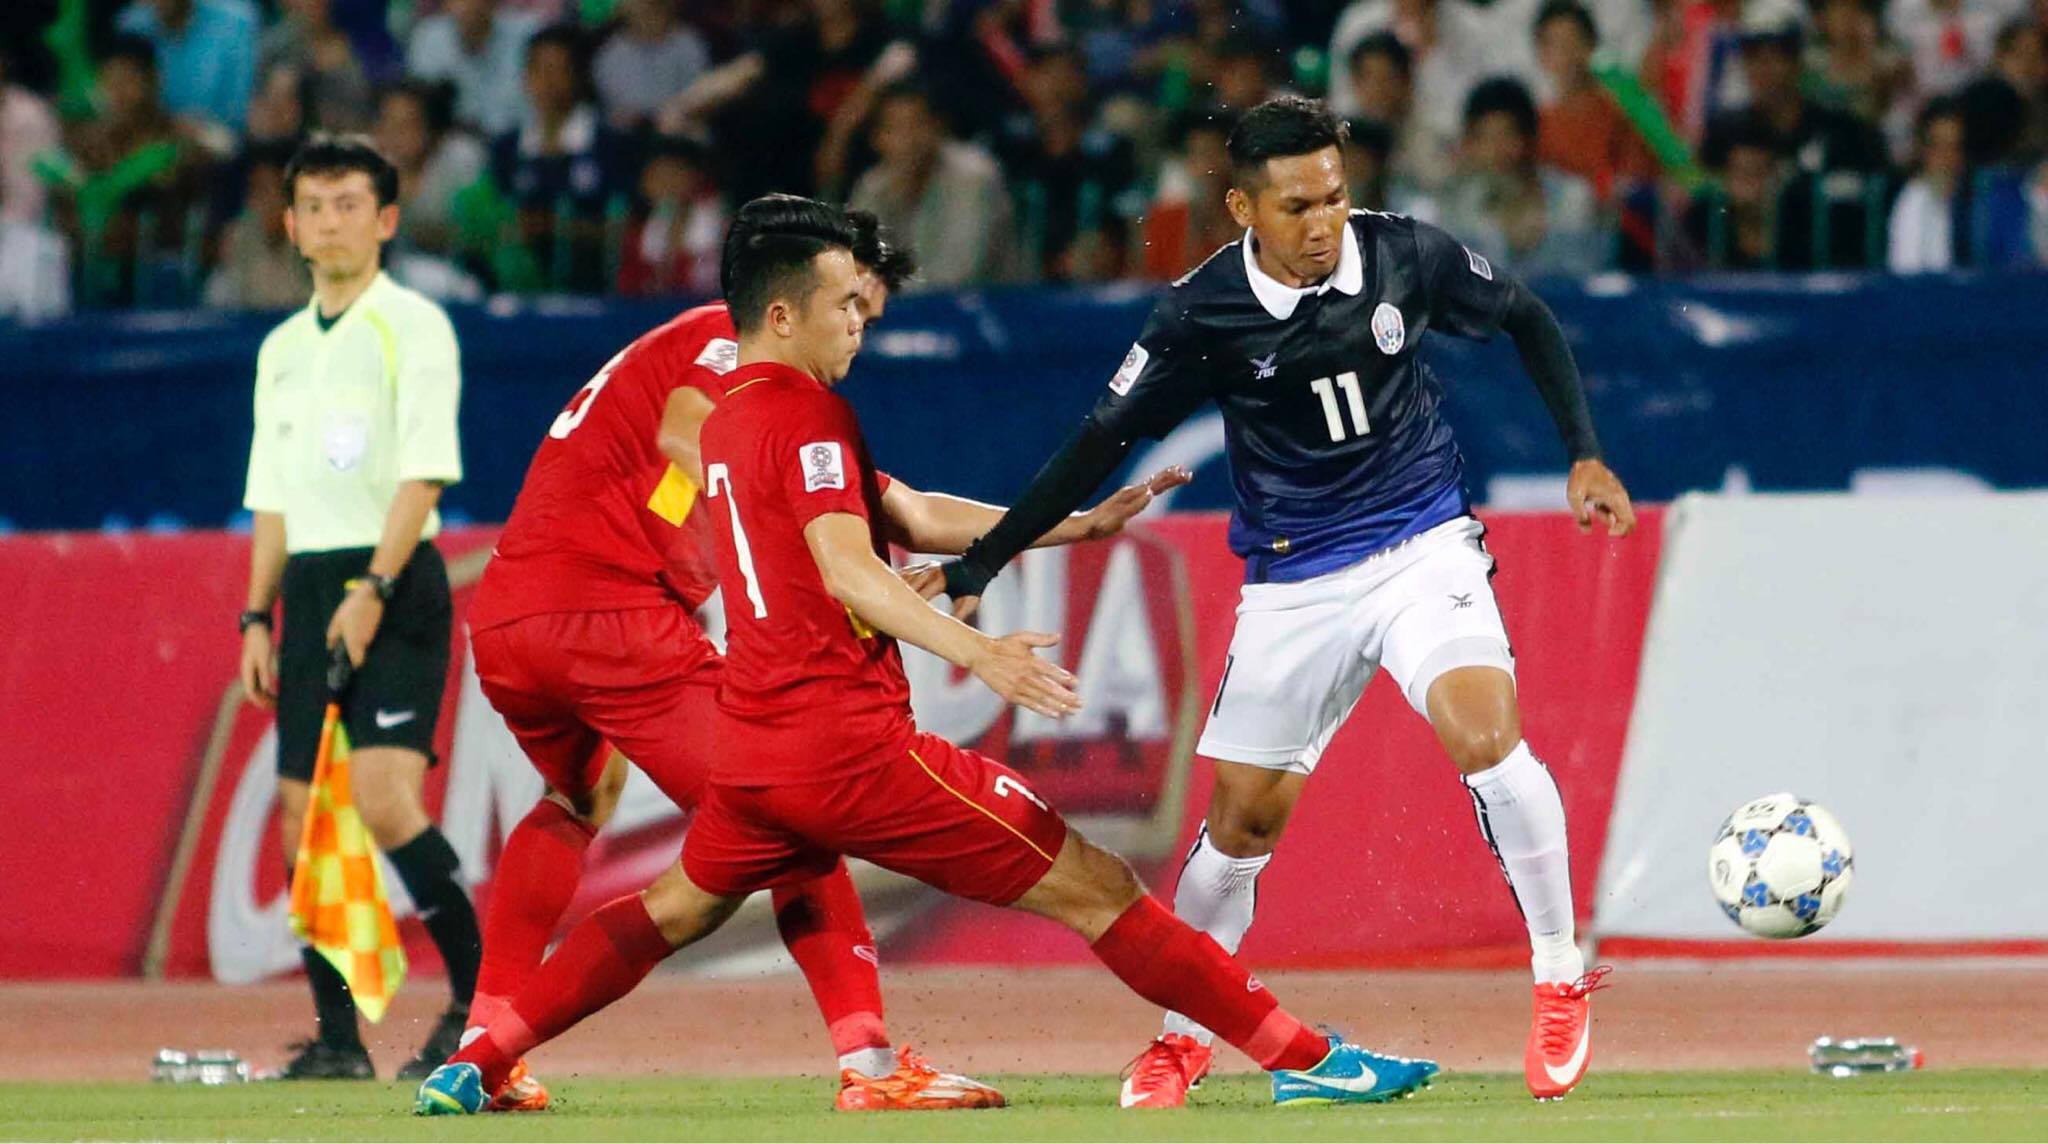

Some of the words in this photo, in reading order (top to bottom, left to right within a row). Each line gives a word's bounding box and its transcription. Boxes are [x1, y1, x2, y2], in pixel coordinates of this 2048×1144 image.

[1310, 371, 1371, 442] 11
[706, 462, 768, 620] 7
[993, 774, 1049, 813] 7
